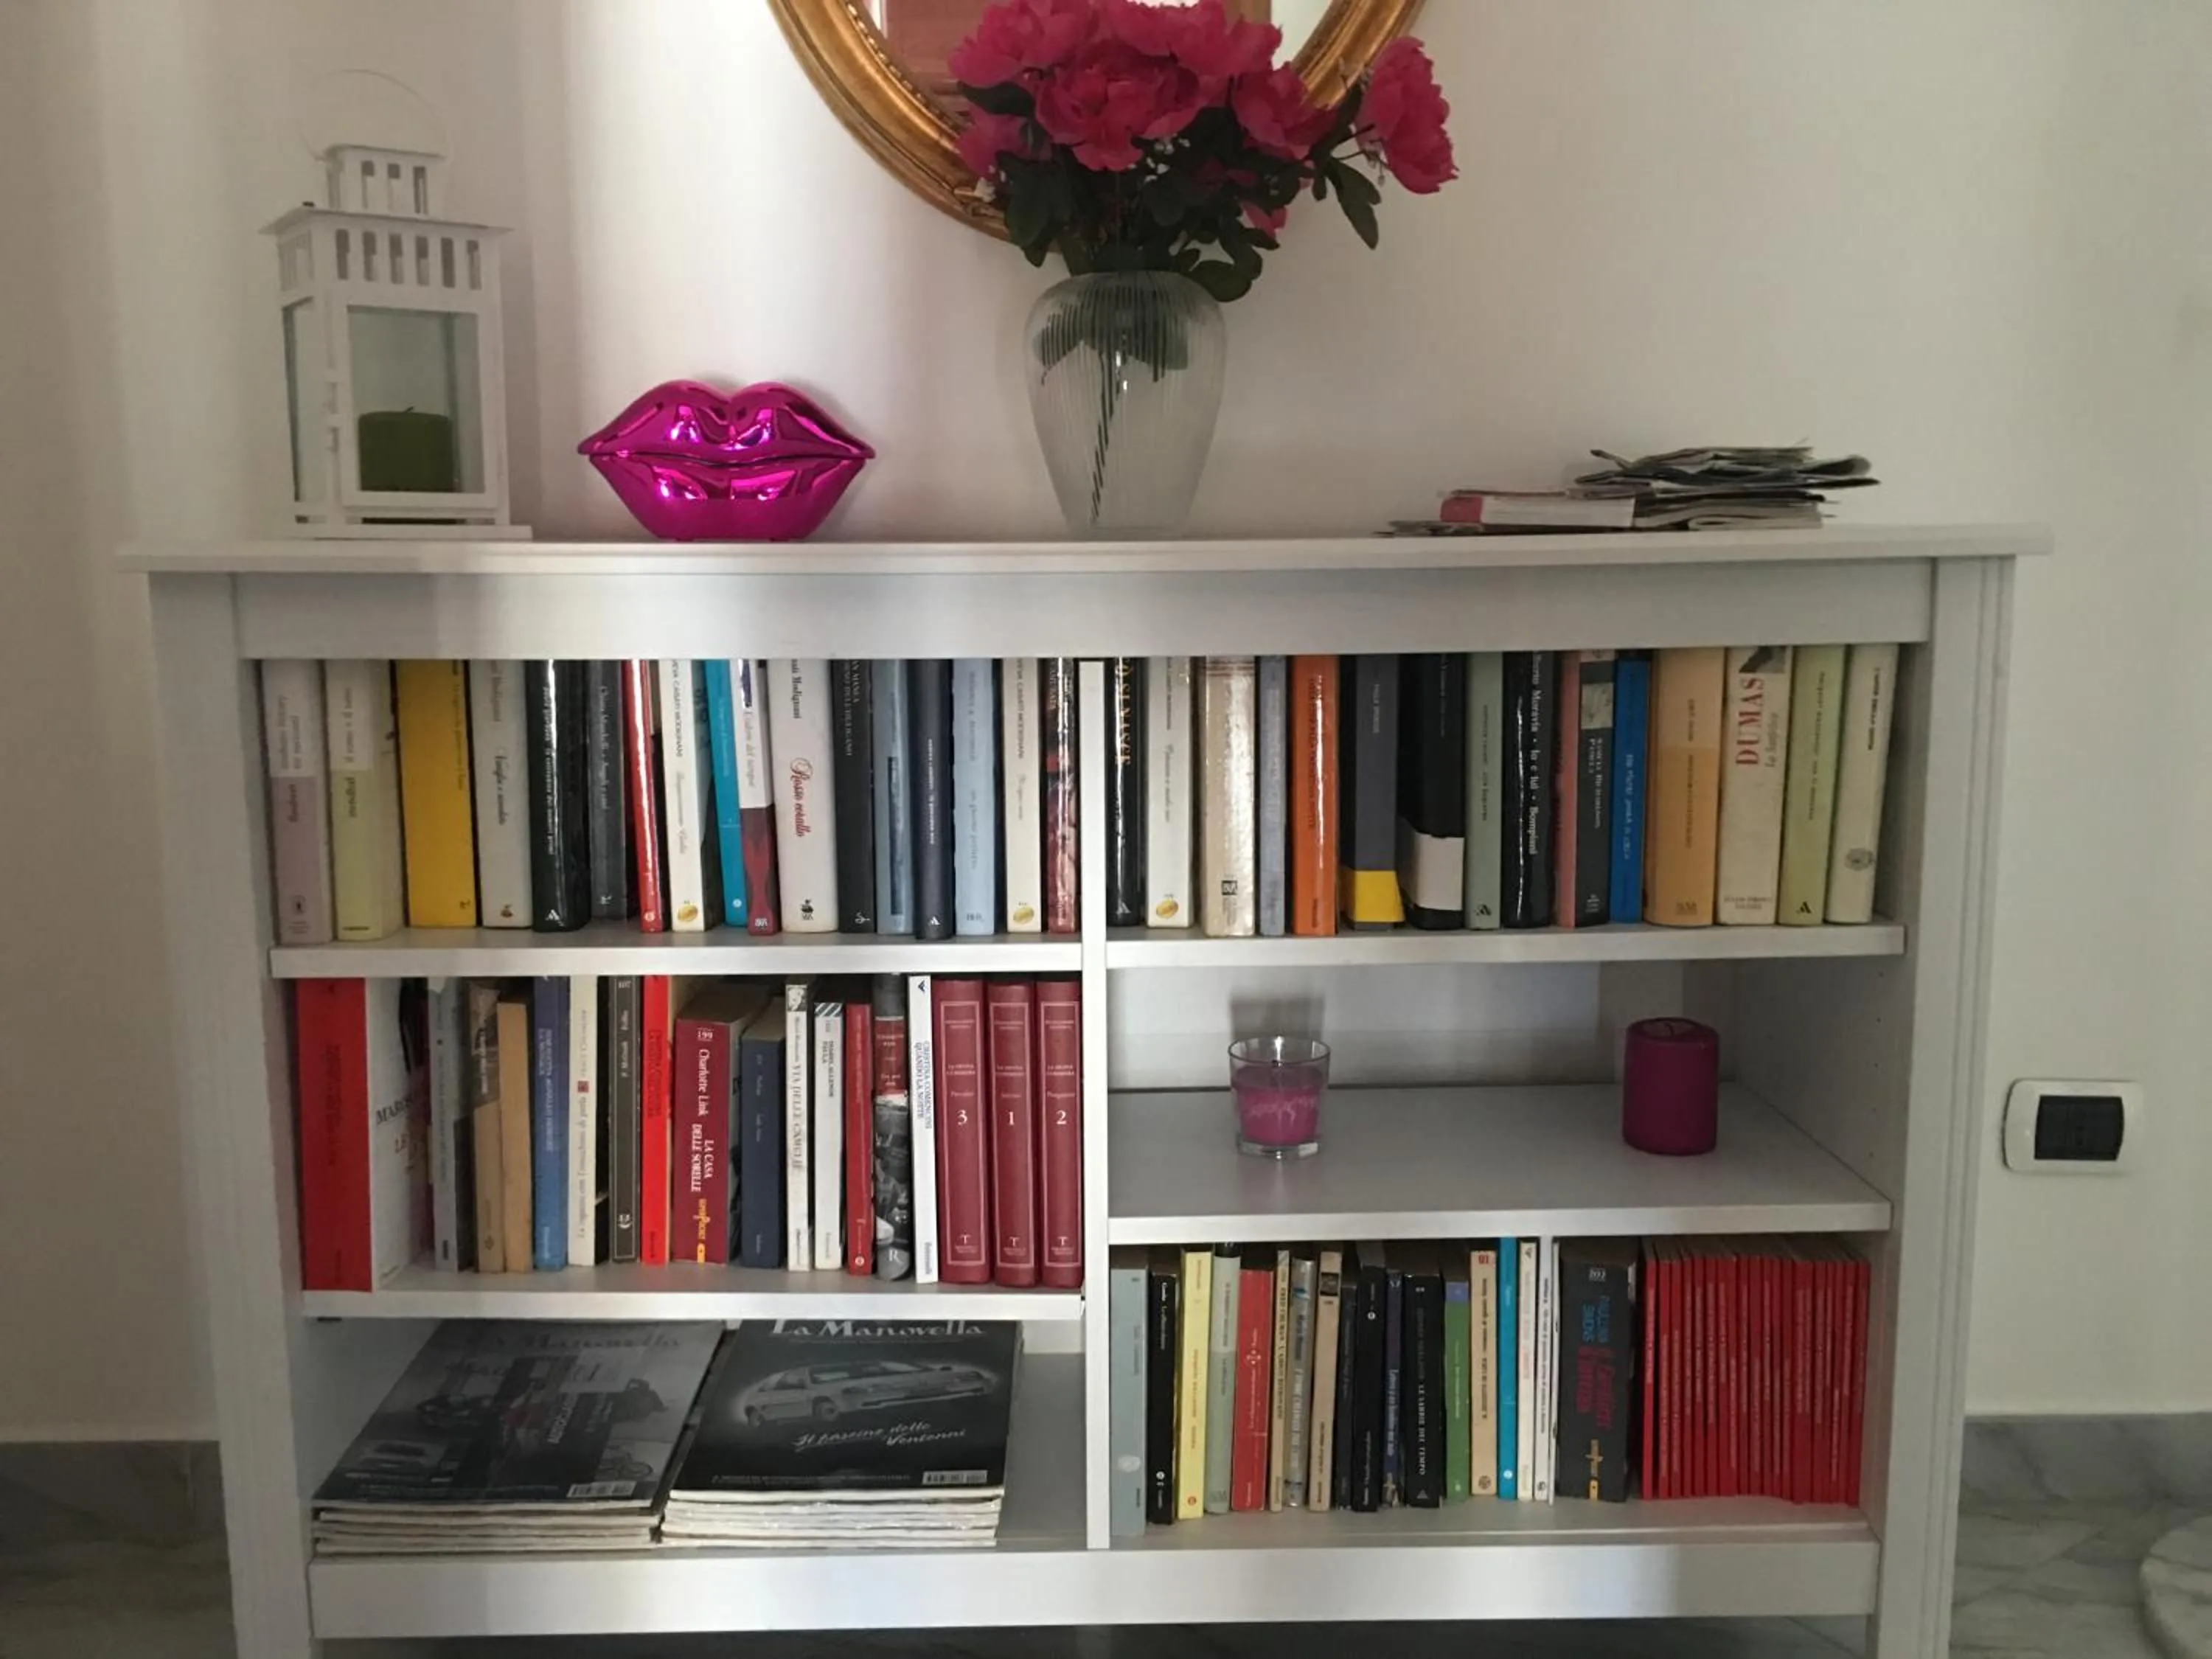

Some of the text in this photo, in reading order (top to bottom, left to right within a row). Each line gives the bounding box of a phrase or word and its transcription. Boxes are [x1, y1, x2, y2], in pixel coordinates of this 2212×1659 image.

[1530, 689, 1544, 732] Moravia
[1735, 677, 1765, 765] DUMAS
[1527, 806, 1539, 855] Bompiani
[697, 1048, 713, 1117] Charlotte Link
[956, 1109, 968, 1126] 3
[1007, 1110, 1015, 1125] 1
[1055, 1109, 1068, 1125] 2
[689, 1123, 704, 1192] DELLE SORELLE
[703, 1138, 715, 1179] LA CASA
[818, 1318, 987, 1337] Manovella
